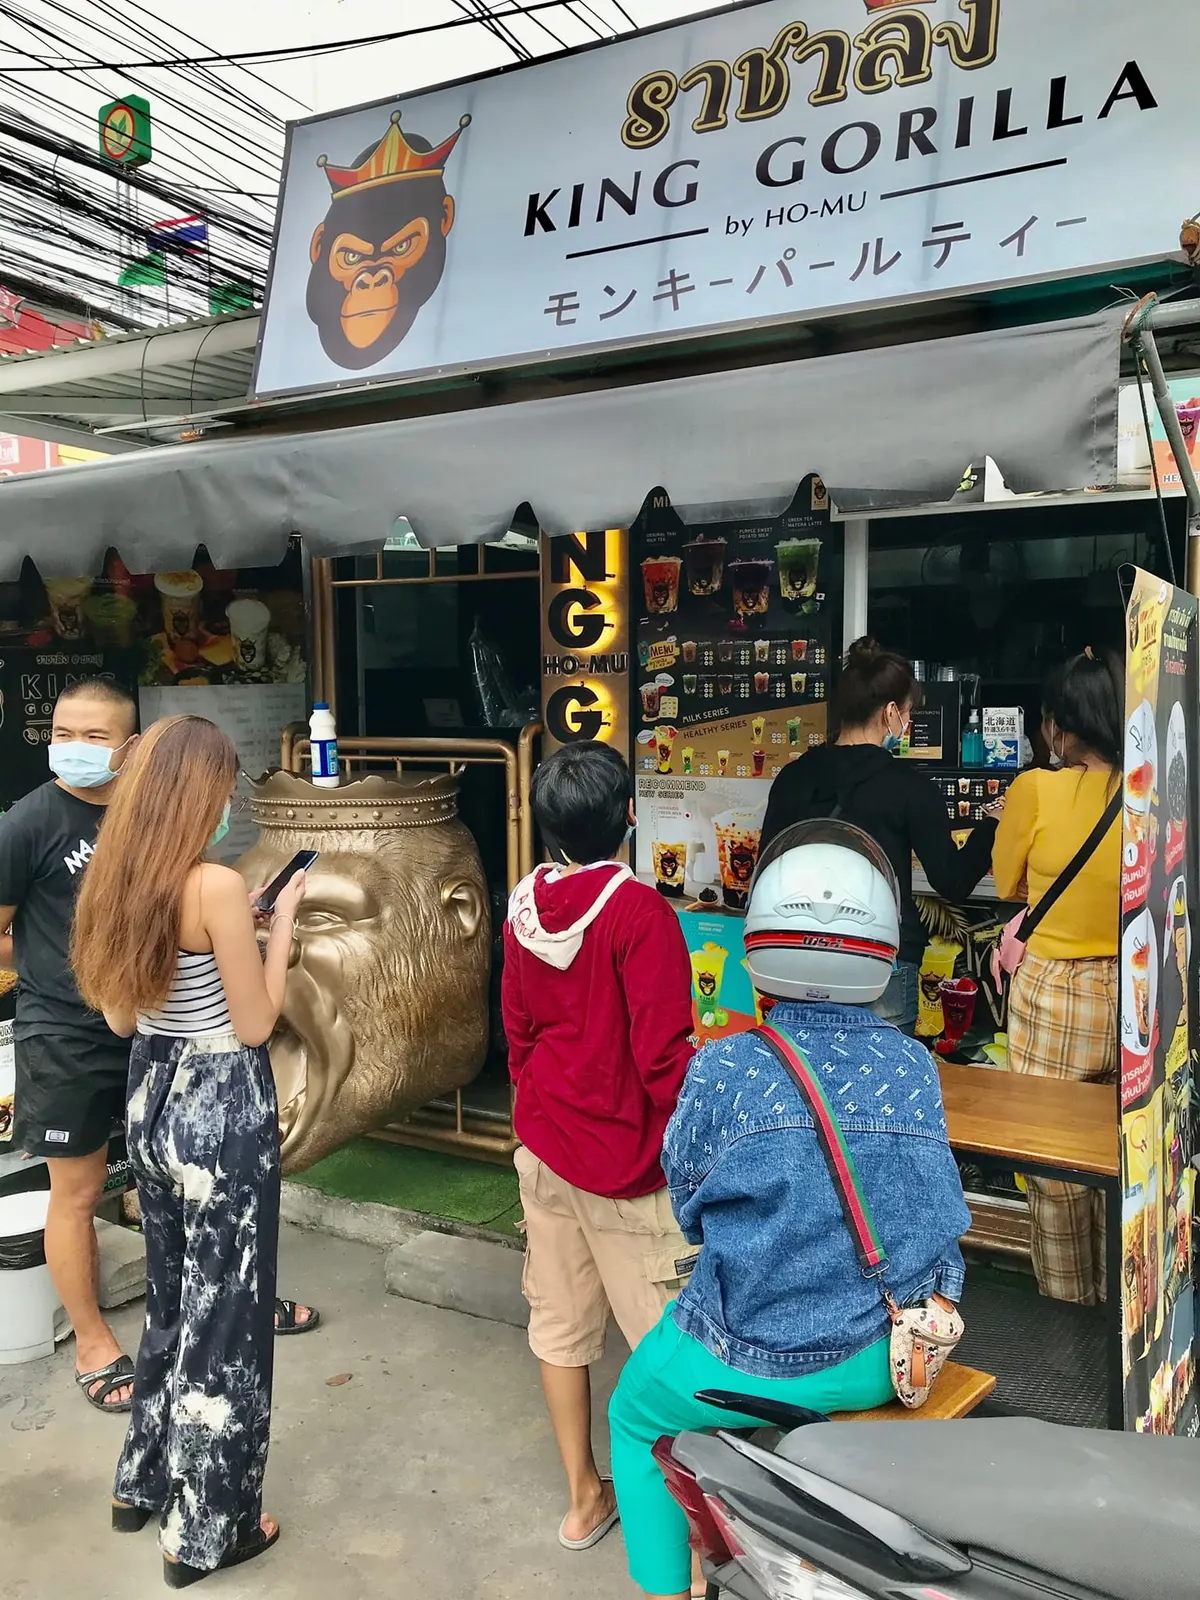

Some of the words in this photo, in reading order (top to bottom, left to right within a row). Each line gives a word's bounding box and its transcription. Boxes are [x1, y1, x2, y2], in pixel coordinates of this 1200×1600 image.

[524, 159, 701, 237] KING
[755, 60, 1159, 188] GORILLA
[725, 216, 754, 237] by
[765, 190, 867, 228] HO-MU
[653, 496, 670, 508] MI
[651, 645, 674, 658] MENU
[542, 652, 629, 676] HO-MU
[682, 713, 702, 724] MILK
[702, 706, 731, 720] SERIES
[984, 715, 1017, 727] 北海道
[683, 726, 719, 740] HEALTHY
[720, 720, 748, 733] SERIES
[638, 778, 707, 792] RECOMMEND
[638, 789, 656, 799] NEW
[657, 790, 685, 800] SERIES
[63, 839, 98, 875] MA
